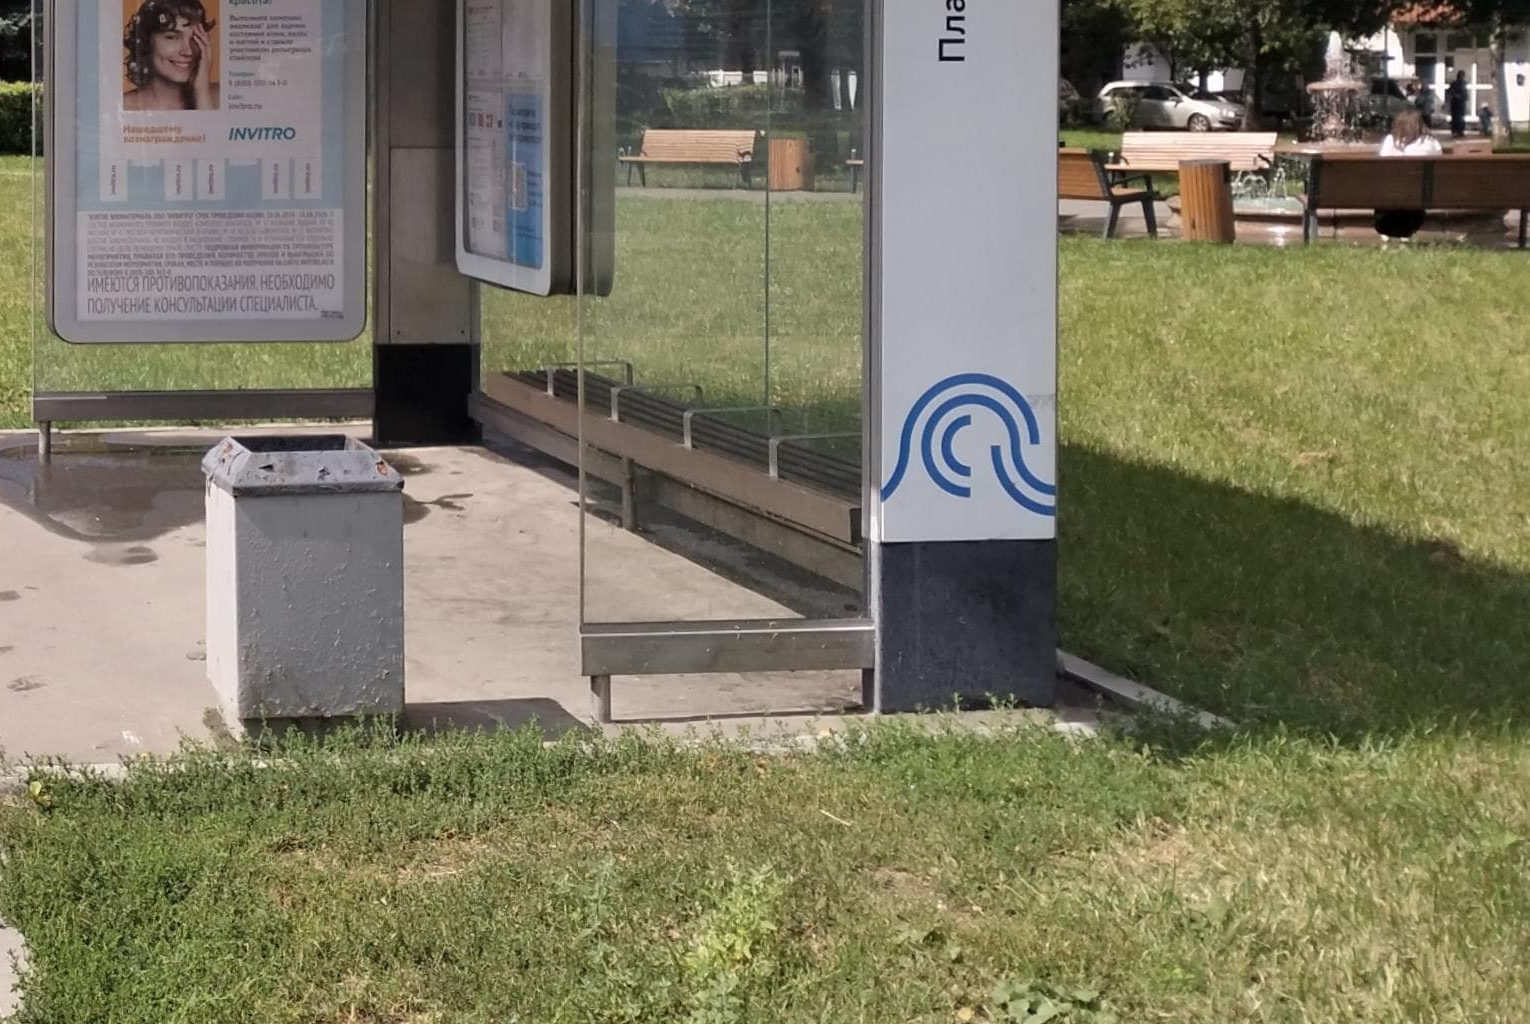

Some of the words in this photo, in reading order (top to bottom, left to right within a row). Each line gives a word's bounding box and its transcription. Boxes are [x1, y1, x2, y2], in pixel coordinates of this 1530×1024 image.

[228, 102, 263, 110] invitro.ru
[123, 125, 183, 136] Нашедшему
[228, 127, 297, 141] INVITRO
[123, 134, 206, 145] вознаграждение!
[87, 276, 139, 293] ИМЕЮТСЯ
[142, 274, 258, 292] ПРОТИВОПОКАЗАНИЯ.
[260, 273, 335, 291] НЕОБХОДИМО
[87, 297, 151, 314] ПОЛУЧЕНИЕ
[154, 296, 237, 314] КОНСУЛЬТАЦИИ
[239, 295, 319, 314] СПЕЦИАЛИСТА.
